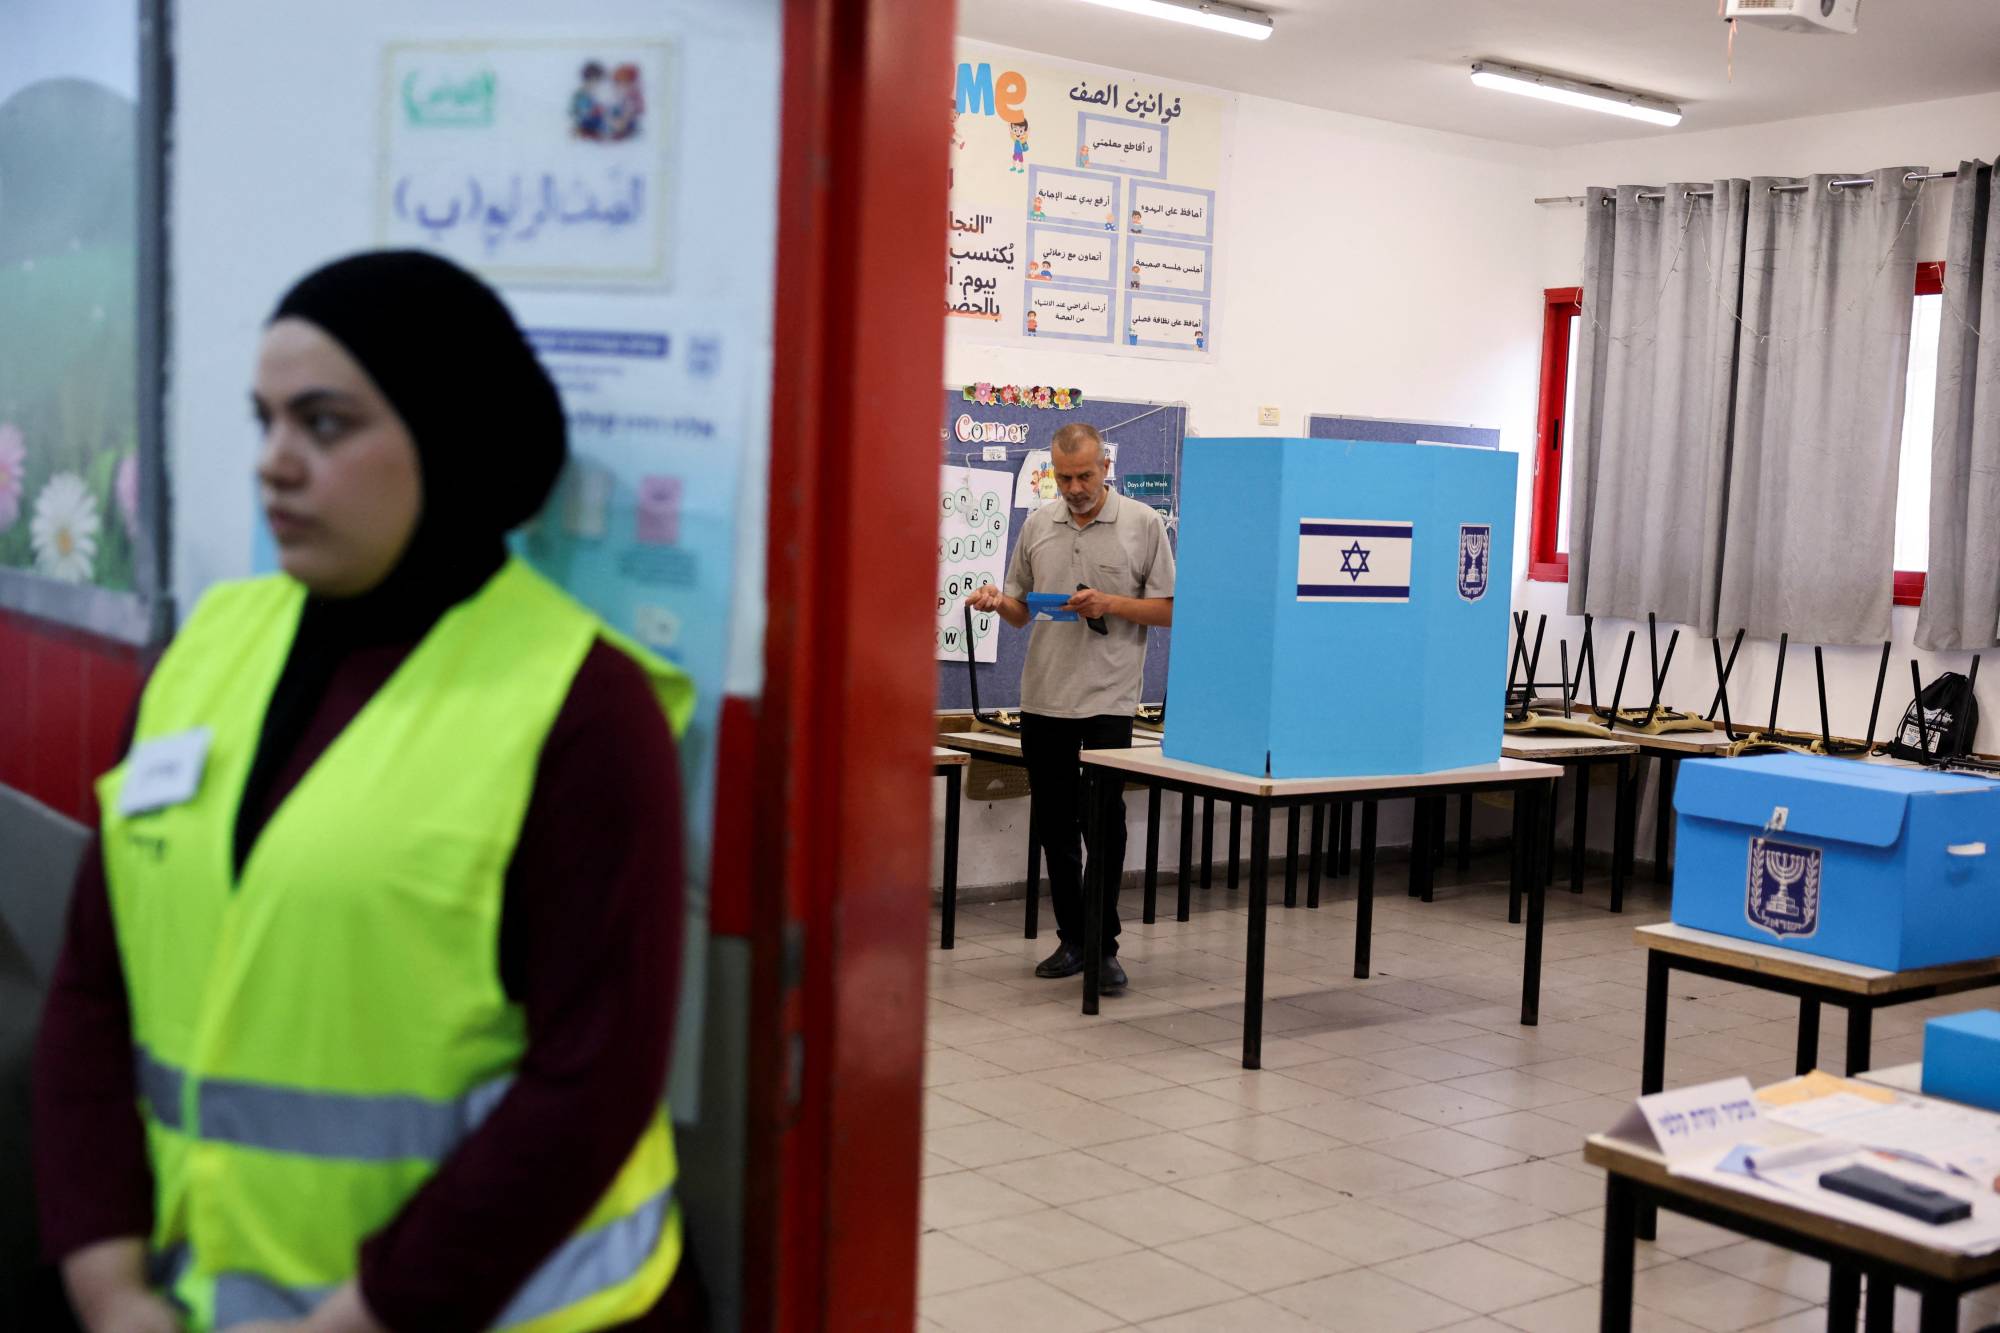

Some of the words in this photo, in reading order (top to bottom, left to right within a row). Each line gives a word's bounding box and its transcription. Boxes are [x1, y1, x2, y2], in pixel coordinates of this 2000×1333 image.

[1069, 81, 1118, 109] الصف
[1125, 91, 1181, 124] قوانين
[956, 414, 1029, 442] Corner
[1127, 481, 1139, 489] Days
